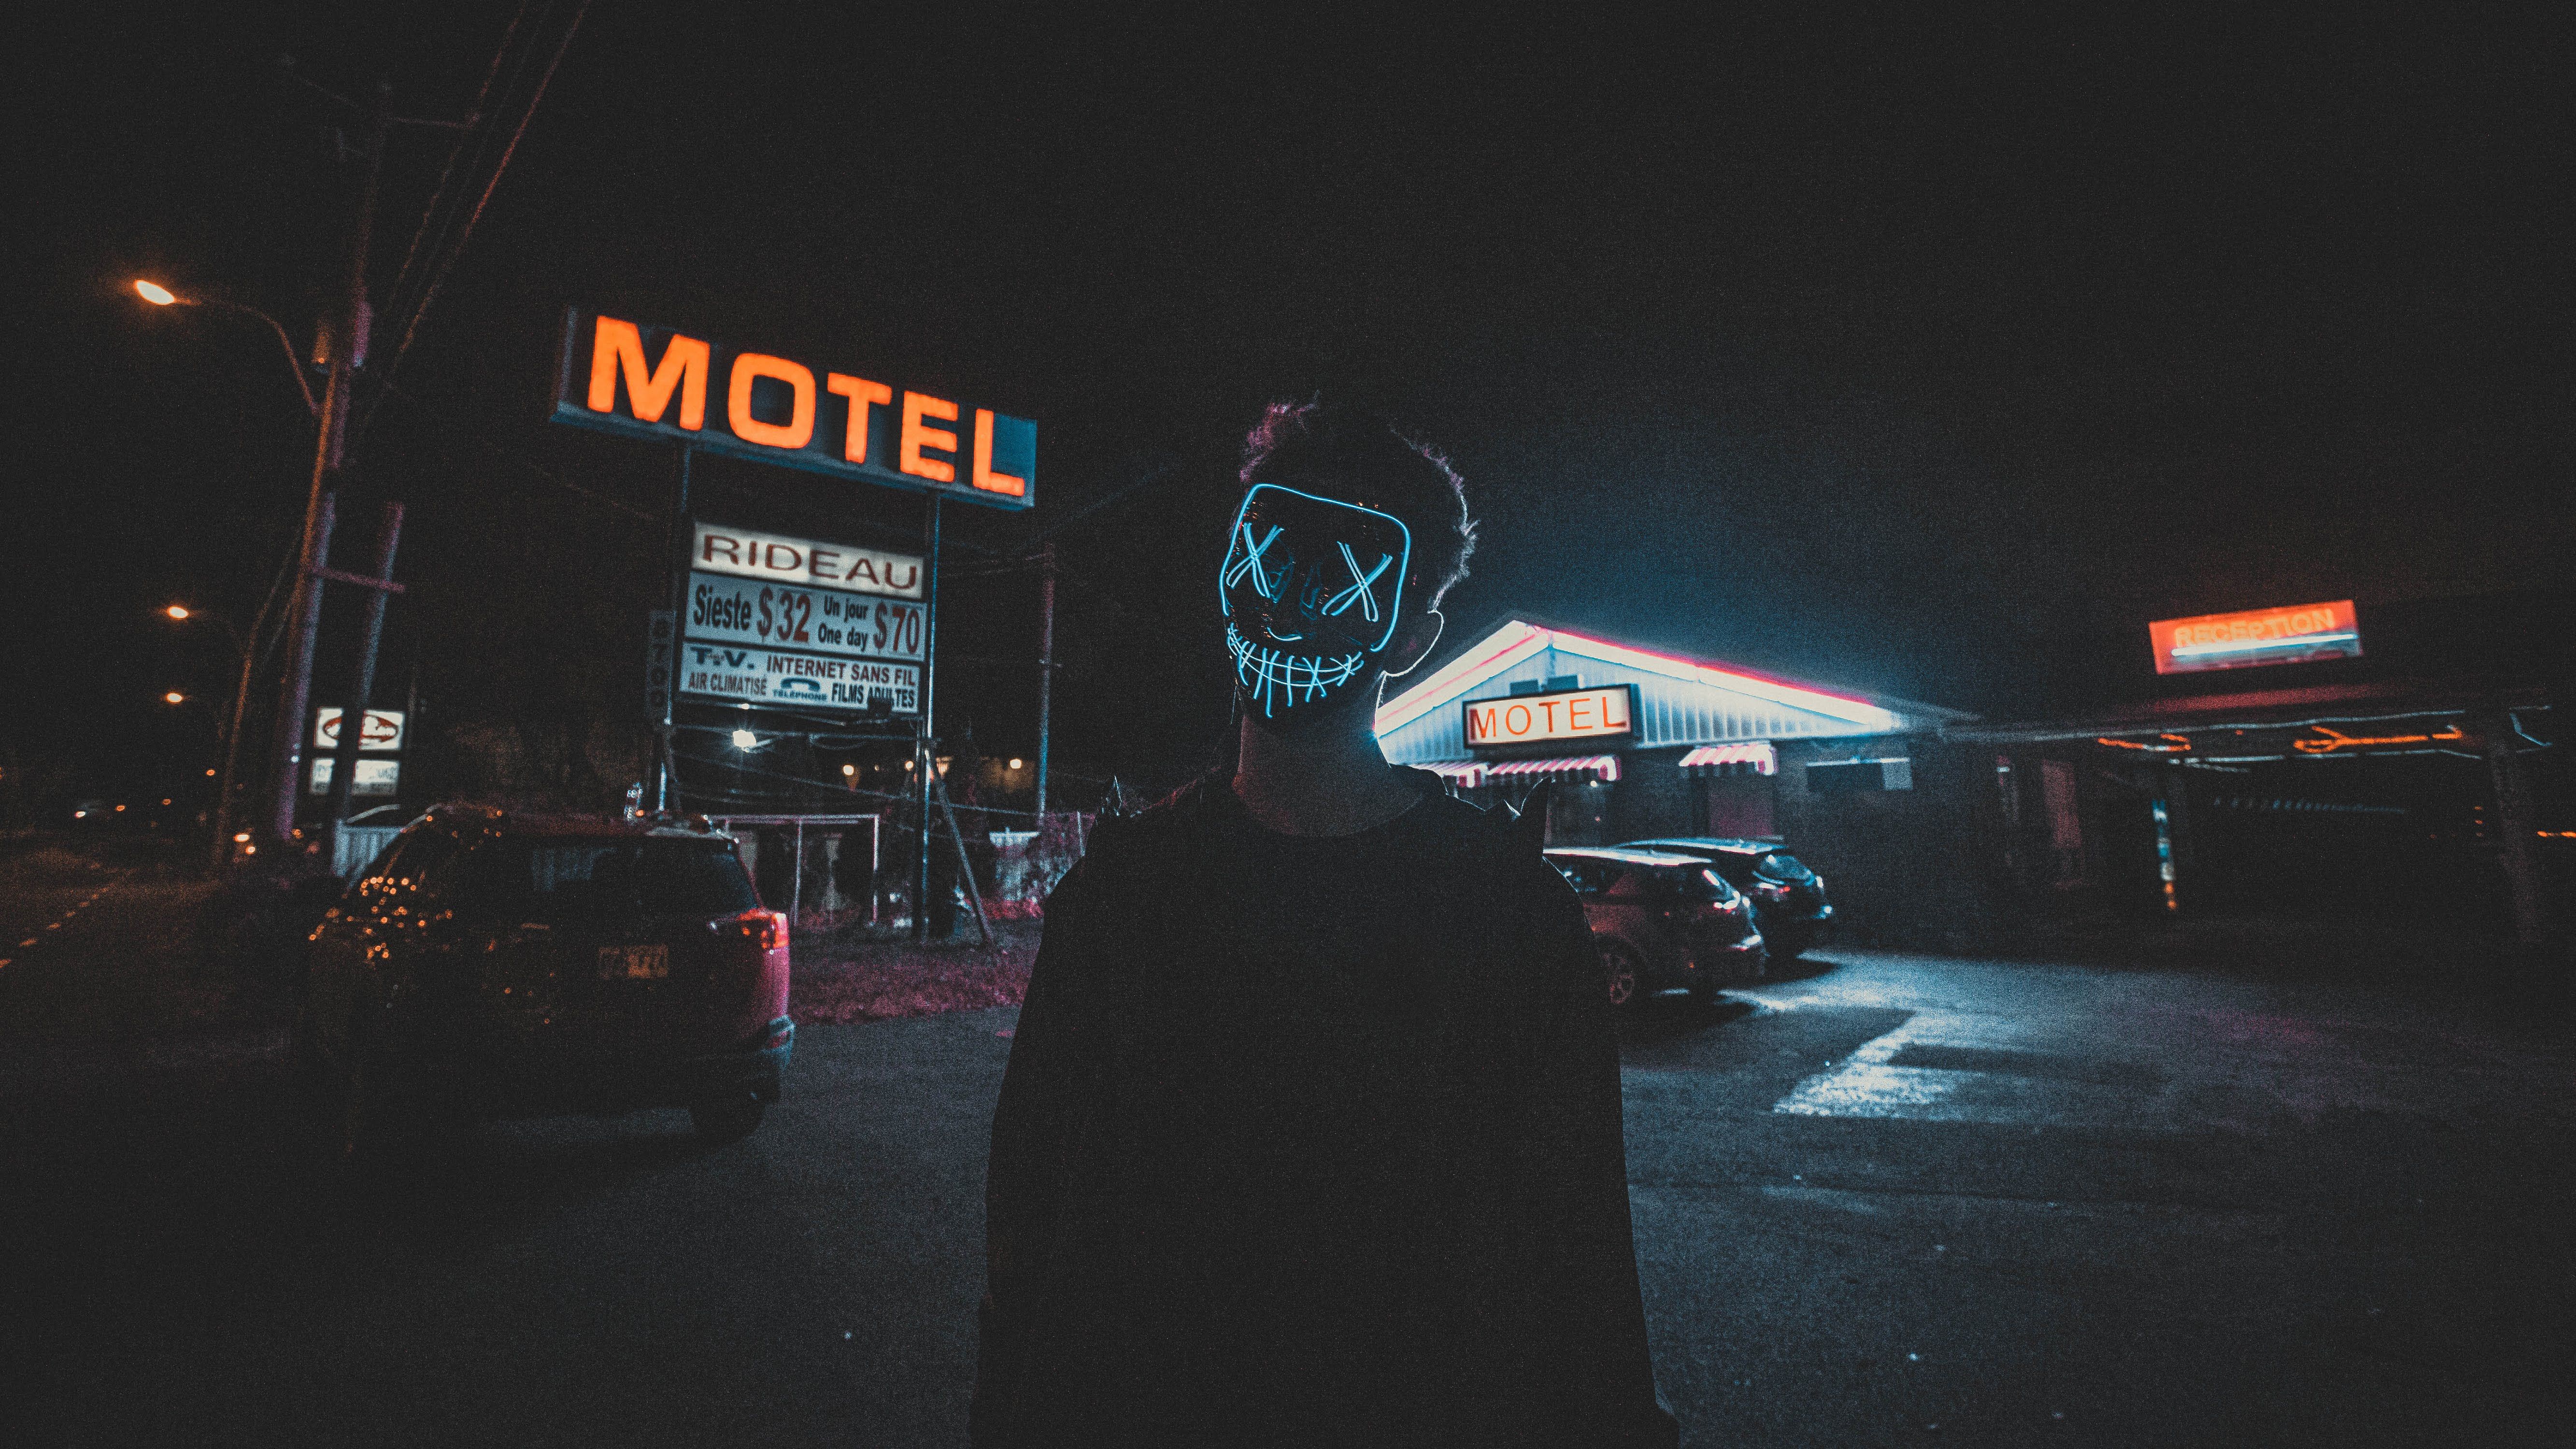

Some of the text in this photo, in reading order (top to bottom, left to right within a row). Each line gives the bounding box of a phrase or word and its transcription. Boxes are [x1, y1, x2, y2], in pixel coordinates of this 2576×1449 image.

[587, 315, 1025, 497] MOTEL
[702, 534, 917, 589] RIDEAU
[693, 583, 751, 631] Sieste
[824, 595, 869, 623] Un jour
[818, 622, 868, 652] One day
[2175, 608, 2335, 648] RECEPTION
[690, 646, 754, 669] T.V.
[767, 655, 915, 686] INTERNET SANS FIL
[688, 672, 708, 690] AIR
[831, 682, 864, 704] FILMS
[1469, 696, 1627, 739] MOTEL
